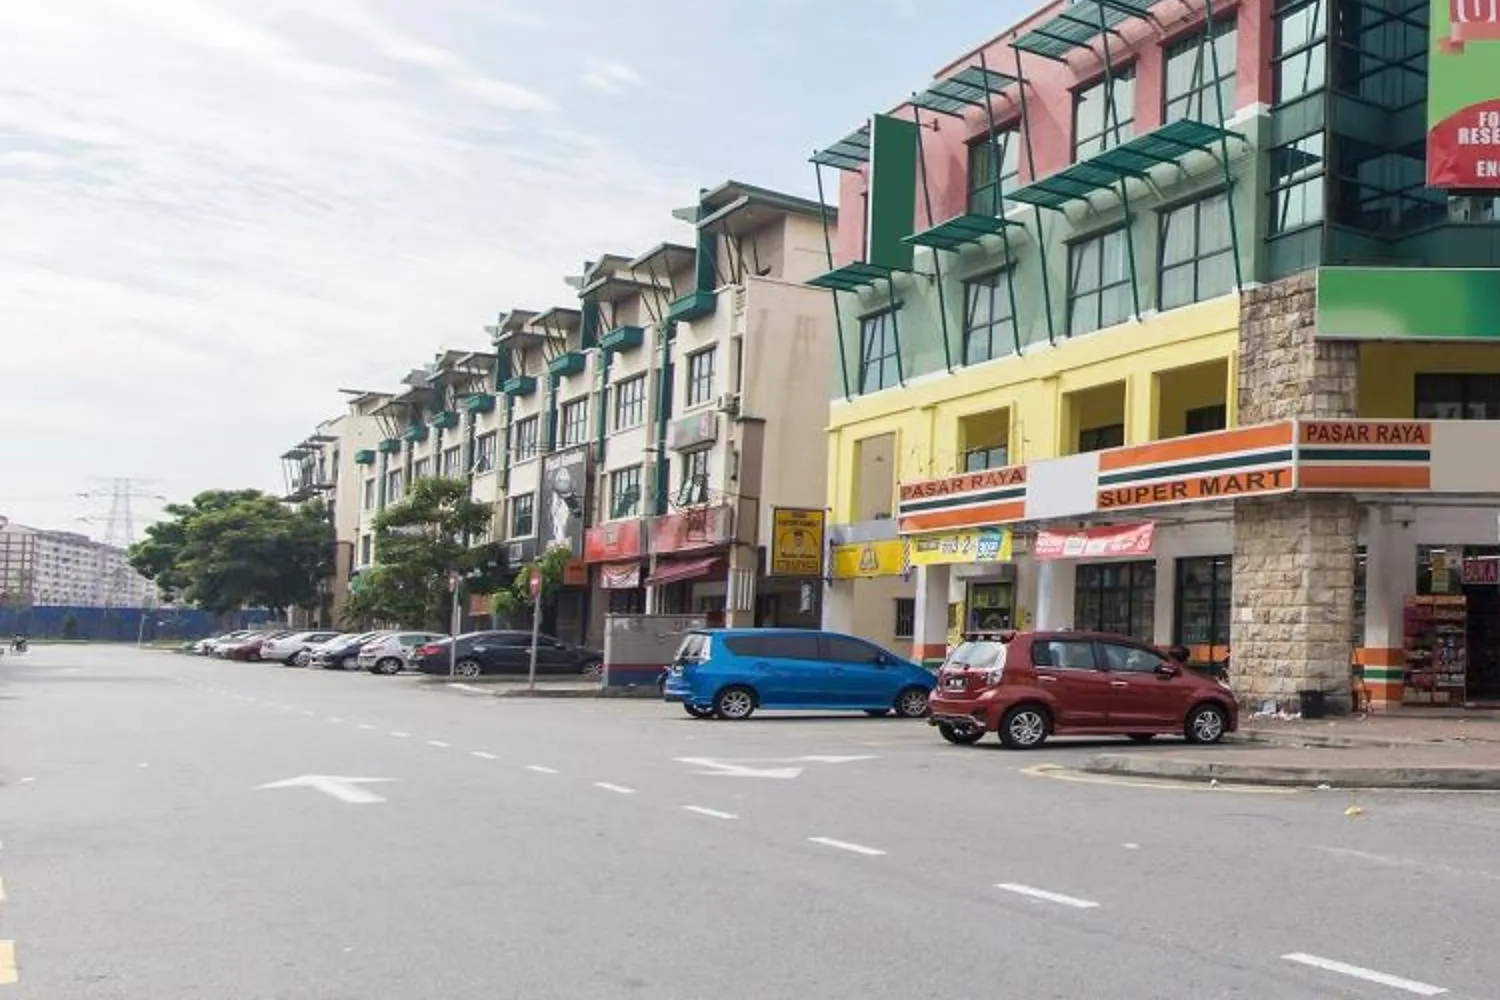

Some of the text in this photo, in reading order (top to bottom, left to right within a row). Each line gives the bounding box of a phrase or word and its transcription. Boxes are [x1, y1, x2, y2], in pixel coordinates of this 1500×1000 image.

[1306, 422, 1426, 445] PASAR RAYA
[901, 467, 1024, 499] PASAR RAYA
[1100, 468, 1288, 508] SUPER MART
[1463, 560, 1497, 581] BUKA
